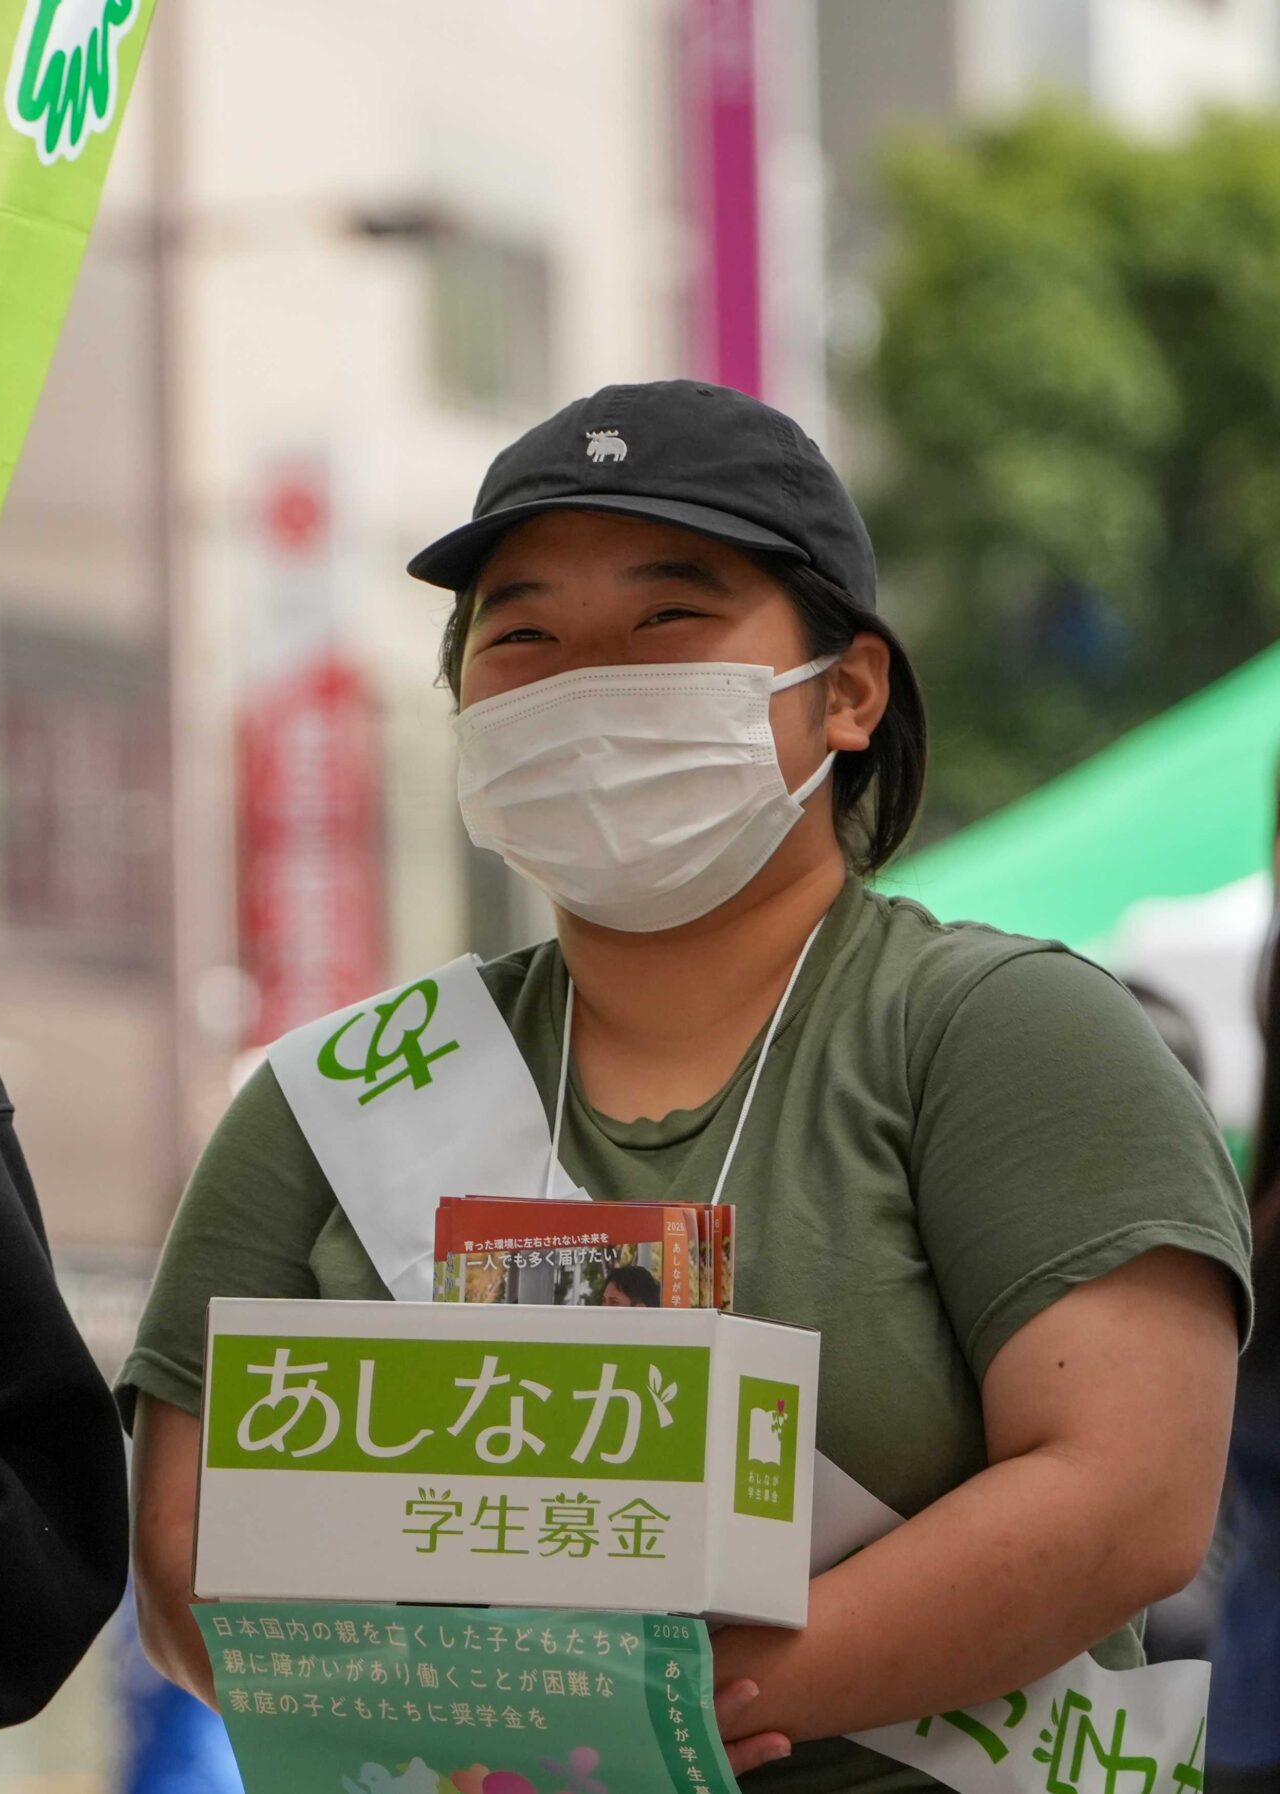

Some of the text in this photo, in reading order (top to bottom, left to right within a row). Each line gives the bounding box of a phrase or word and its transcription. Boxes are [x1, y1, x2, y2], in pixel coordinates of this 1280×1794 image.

[316, 978, 460, 1107] あ
[464, 1232, 609, 1251] 育った環境に左右されない未来を
[466, 1247, 618, 1271] 一人でも多く届けたい
[236, 1347, 679, 1465] あしなが
[402, 1486, 671, 1561] 学生募金
[212, 1616, 641, 1657] 日本国内の親を亡くした子どもたちや
[653, 1624, 690, 1639] 2026
[223, 1649, 615, 1698] 親に障がいがあり働くことが困難な
[228, 1688, 549, 1730] 家庭の子どもたちに奨学金を
